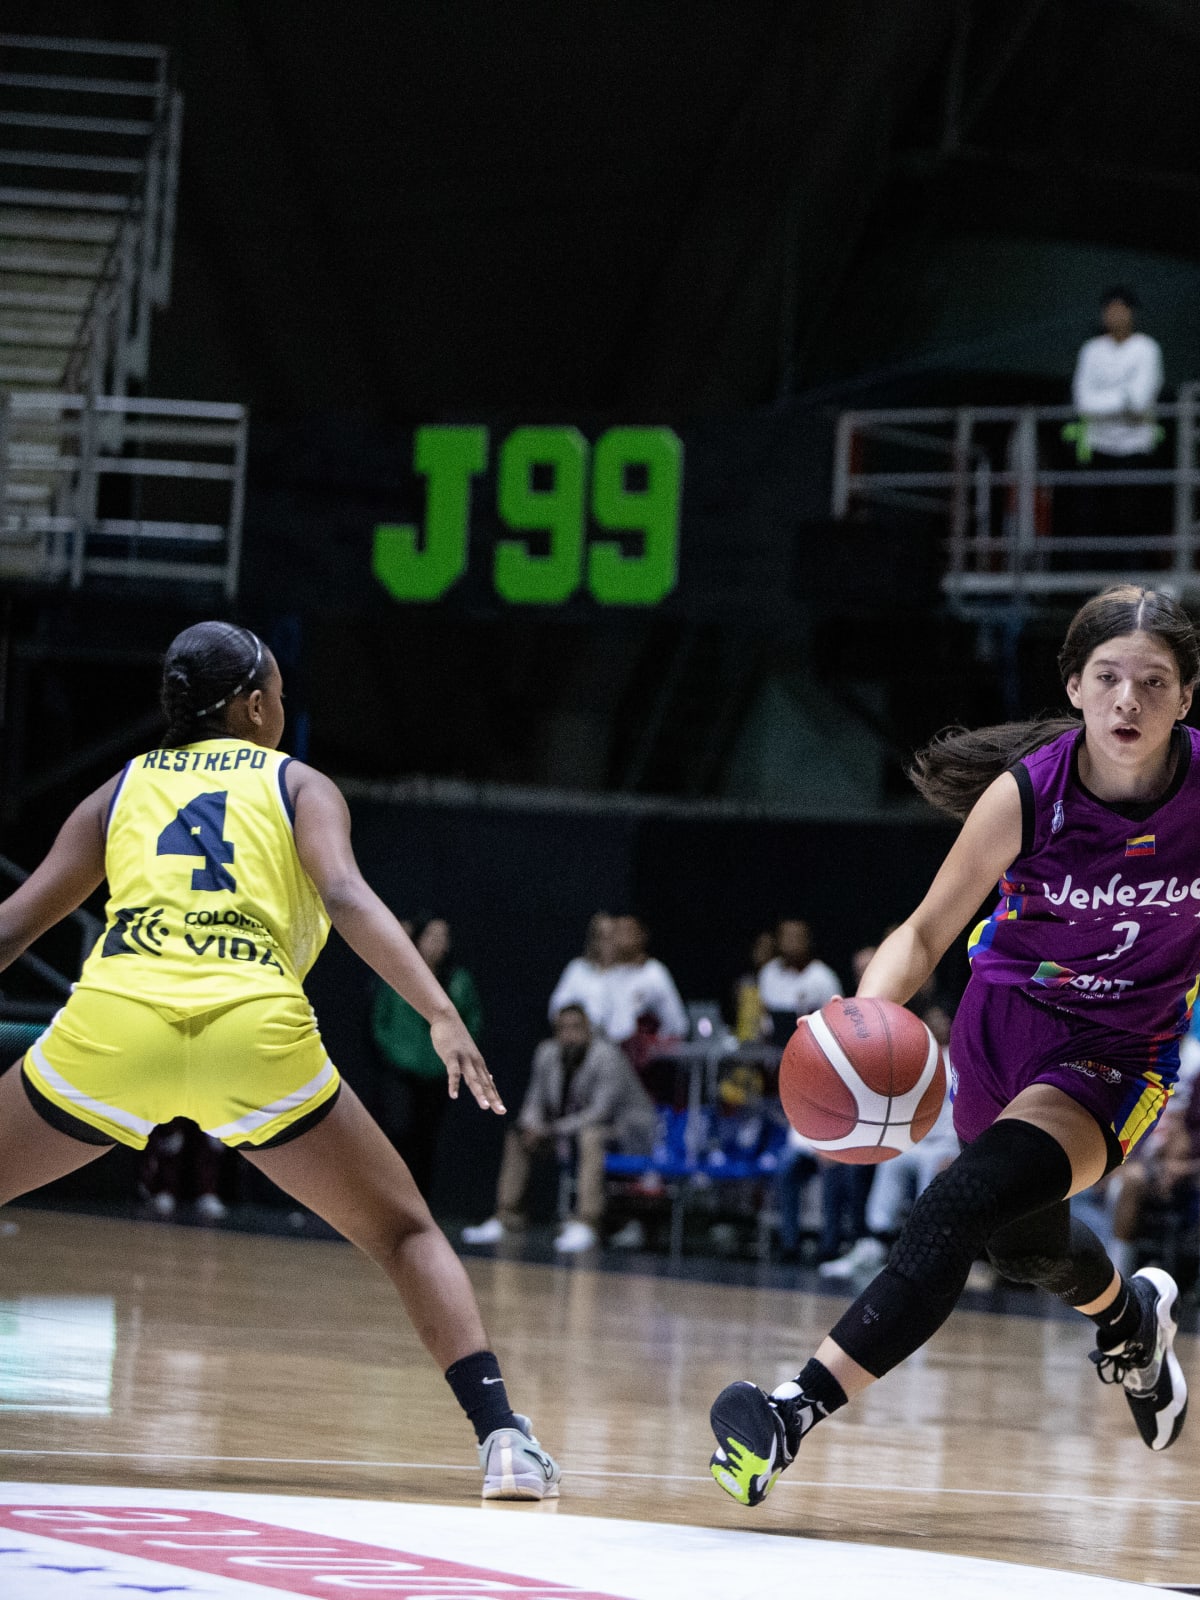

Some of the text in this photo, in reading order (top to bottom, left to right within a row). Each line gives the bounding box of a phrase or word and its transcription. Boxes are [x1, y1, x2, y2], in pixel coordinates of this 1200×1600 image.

[143, 748, 267, 772] RESTREPO
[156, 790, 237, 894] 4
[184, 933, 285, 977] VIDA
